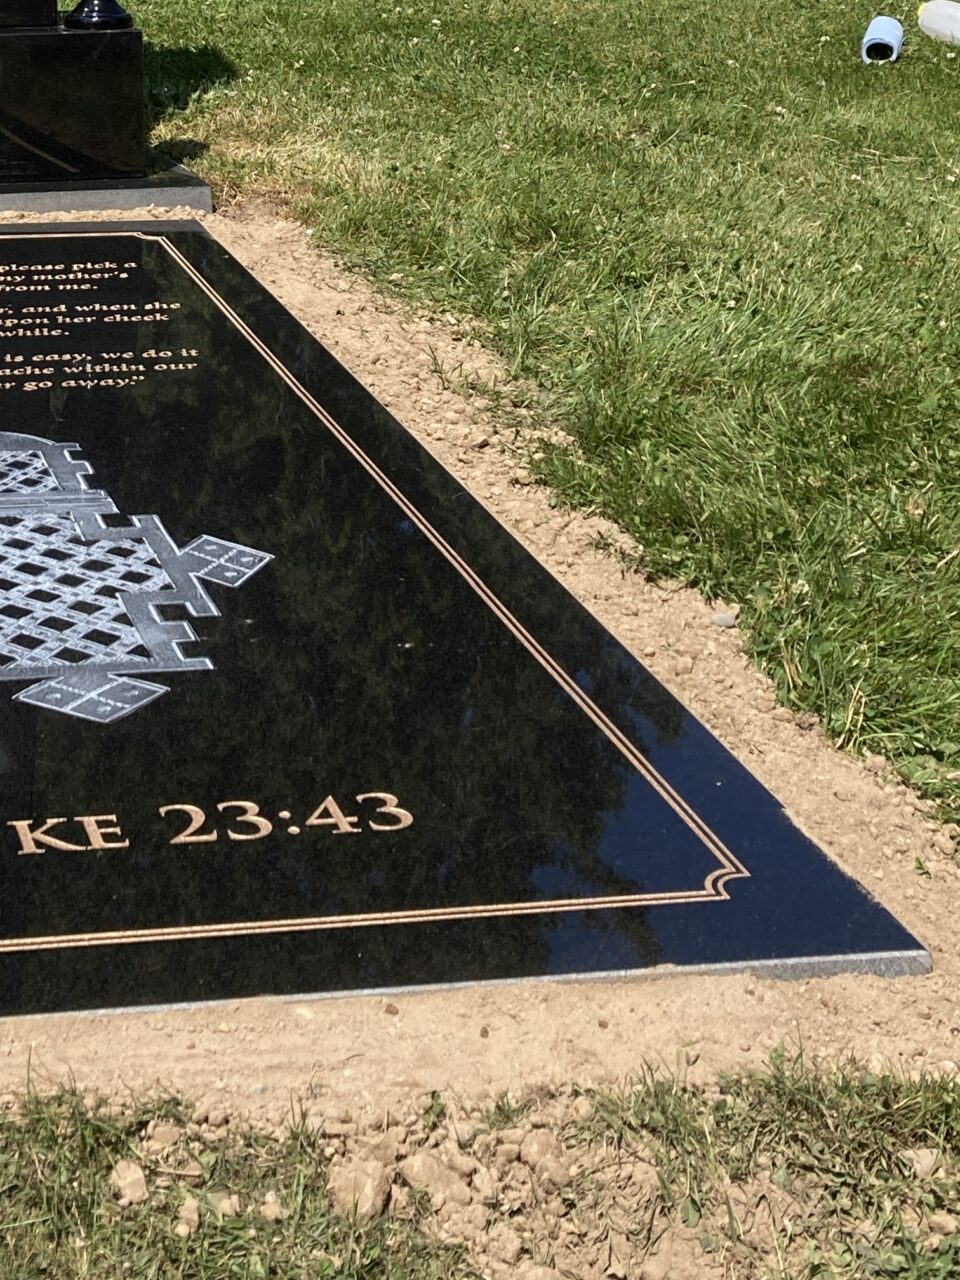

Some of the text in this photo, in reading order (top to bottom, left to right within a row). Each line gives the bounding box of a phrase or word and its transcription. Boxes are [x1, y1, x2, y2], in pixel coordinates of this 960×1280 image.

[71, 260, 119, 271] pick
[124, 261, 138, 269] a
[32, 270, 129, 282] mother's
[58, 282, 99, 291] me.
[21, 304, 68, 314] and
[74, 302, 138, 312] when
[144, 301, 182, 311] she
[56, 315, 97, 325] her
[103, 313, 171, 323] cheek
[5, 353, 25, 363] is
[31, 352, 92, 364] easy,
[101, 350, 135, 360] we
[142, 348, 173, 359] do
[179, 347, 200, 357] it
[63, 362, 146, 374] within
[153, 361, 198, 372] our
[22, 380, 53, 391] go
[158, 791, 415, 845] 23:43
